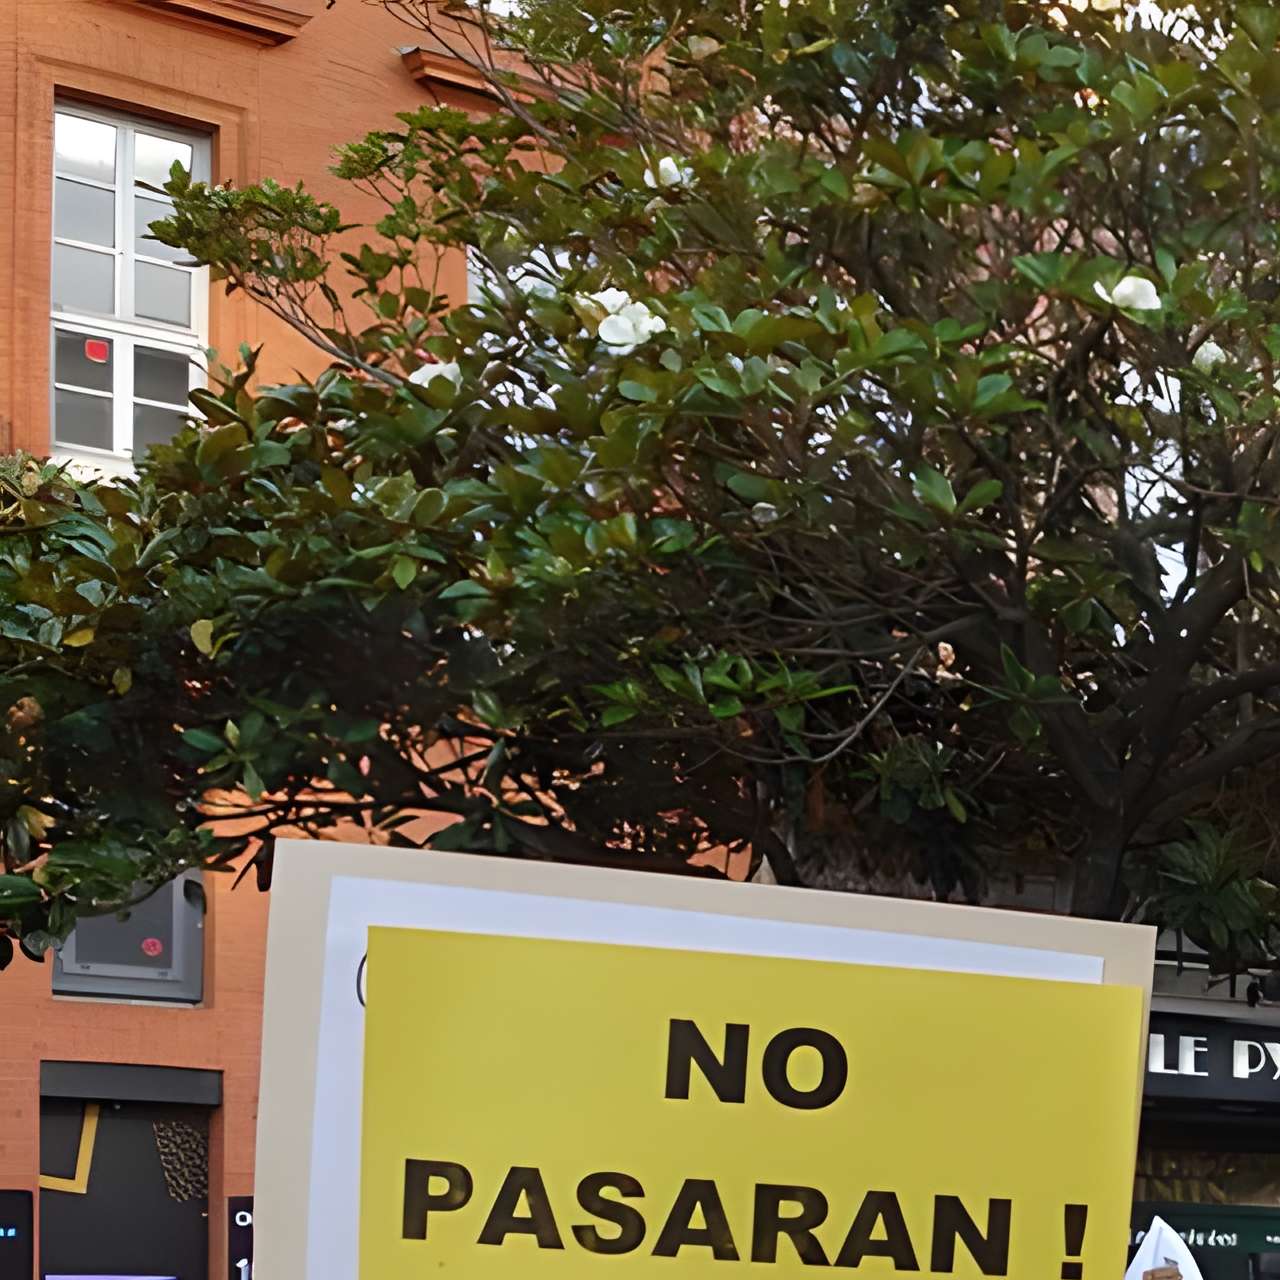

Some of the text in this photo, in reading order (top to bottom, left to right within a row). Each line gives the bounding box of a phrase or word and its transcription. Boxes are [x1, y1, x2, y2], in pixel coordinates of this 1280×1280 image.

[664, 1019, 848, 1110] NO
[1149, 1033, 1208, 1077] LE
[402, 1158, 1090, 1280] PASARAN !
